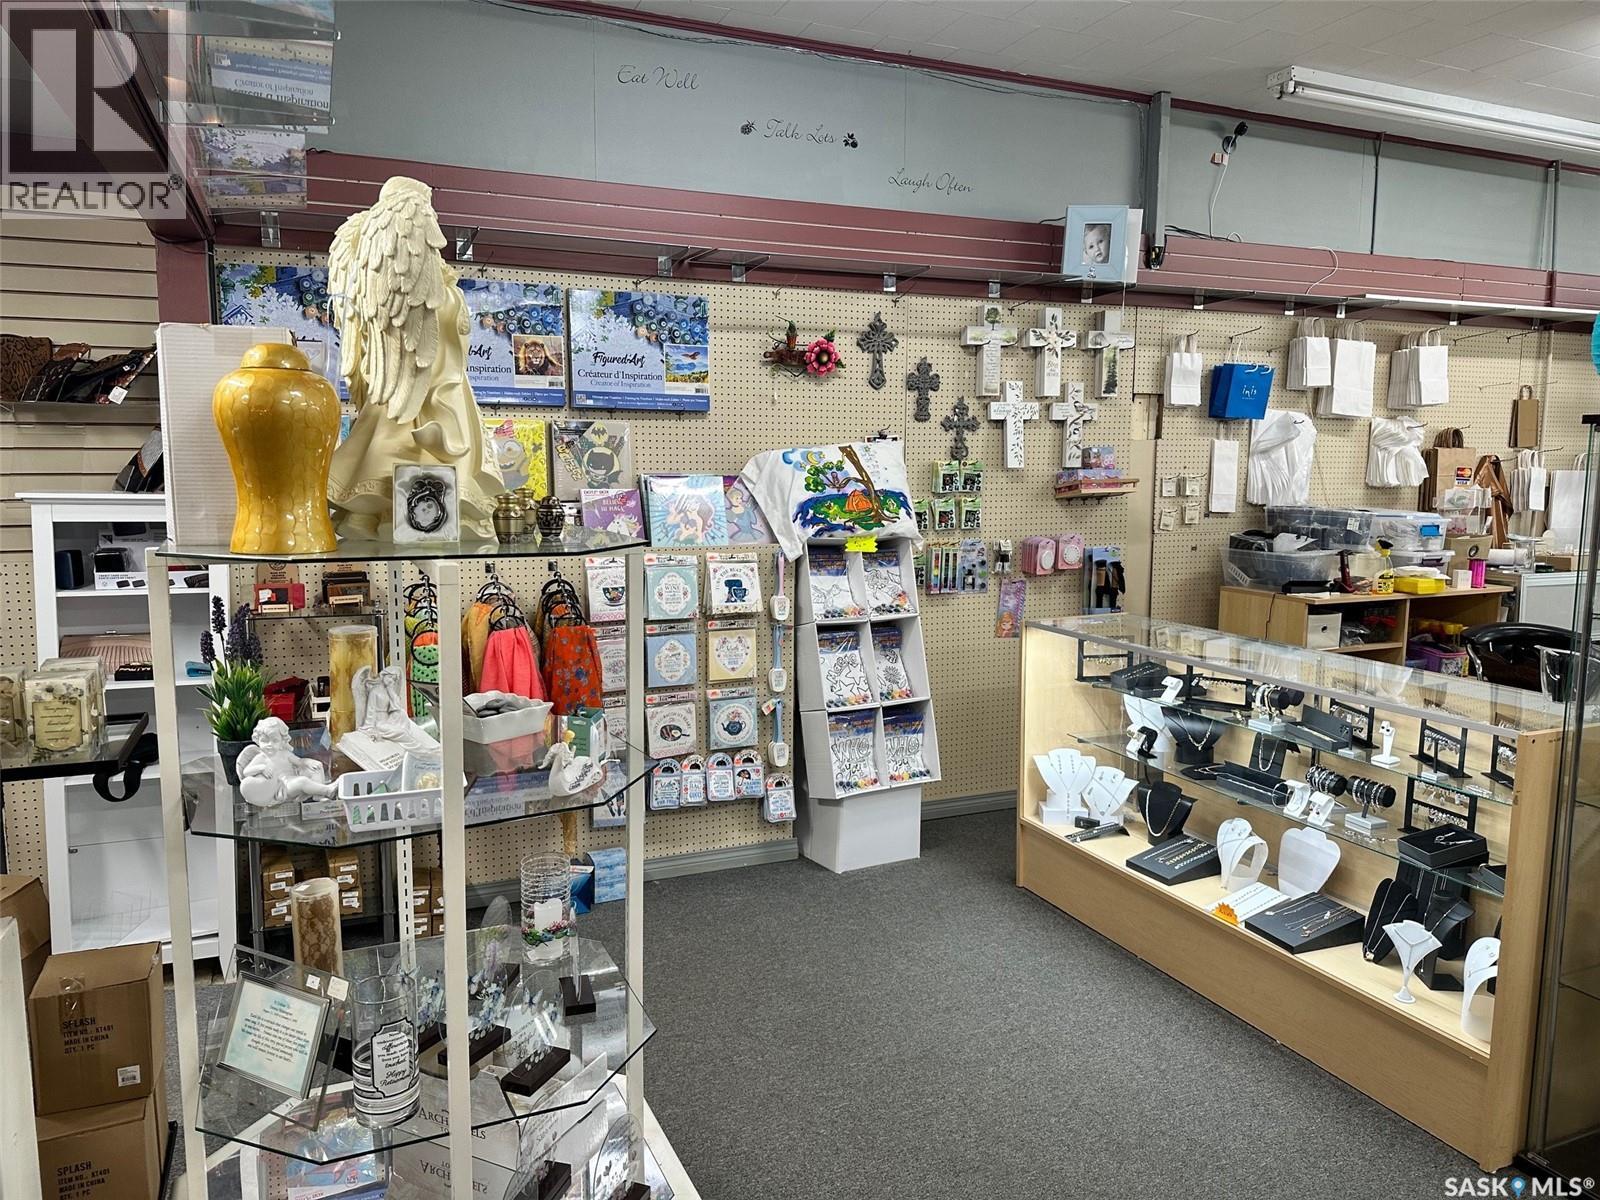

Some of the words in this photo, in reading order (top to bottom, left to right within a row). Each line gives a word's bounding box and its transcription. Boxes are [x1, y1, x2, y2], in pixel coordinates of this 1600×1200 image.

[617, 65, 649, 85] Eat
[654, 66, 700, 90] Well
[764, 118, 803, 140] Talk
[806, 124, 836, 145] Lots
[887, 168, 932, 190] Laugh
[935, 172, 974, 194] Often
[577, 368, 613, 379] Créateur
[1242, 384, 1257, 397] inis
[90, 1034, 109, 1042] CHINA
[57, 1161, 92, 1176] SPLASH
[59, 1185, 76, 1193] MADE
[86, 1178, 105, 1187] CHINA
